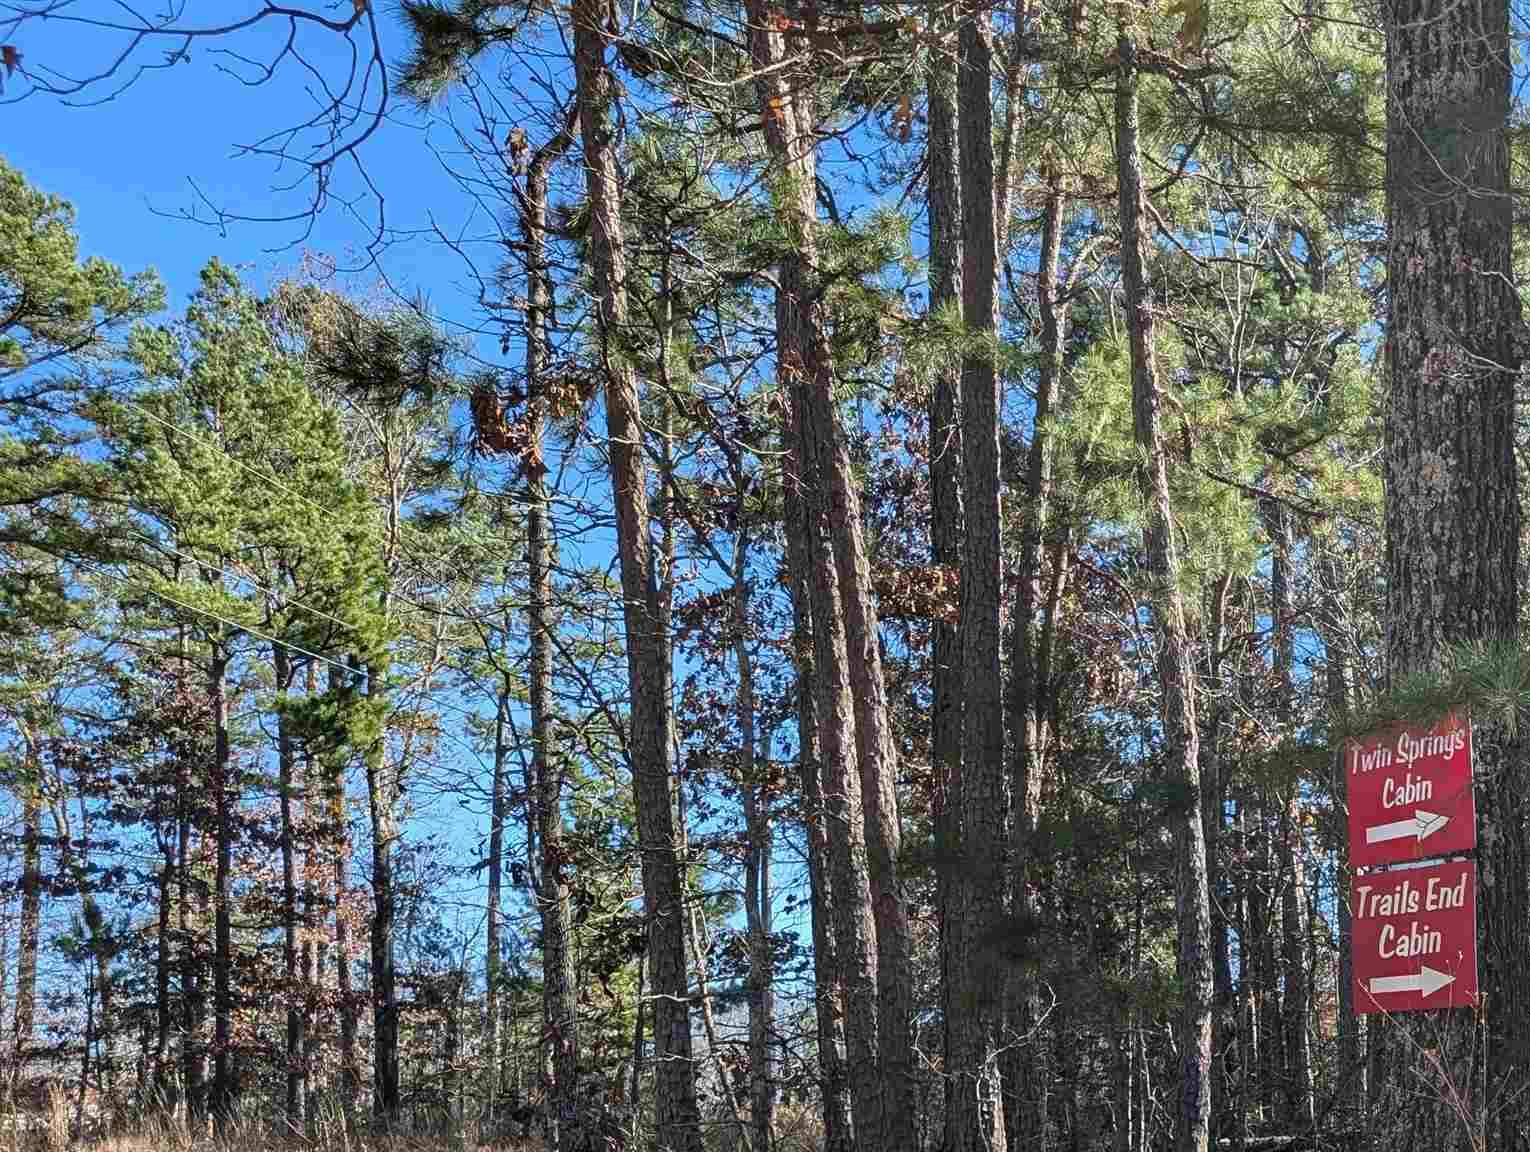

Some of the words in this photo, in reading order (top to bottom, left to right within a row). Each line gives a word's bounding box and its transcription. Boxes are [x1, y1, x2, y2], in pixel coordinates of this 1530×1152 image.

[1350, 743, 1392, 774] Twin
[1396, 728, 1465, 768] Springs
[1382, 774, 1432, 809] Cabin
[1357, 880, 1419, 919] Trails
[1424, 872, 1468, 909] End
[1378, 921, 1442, 960] Cabin
